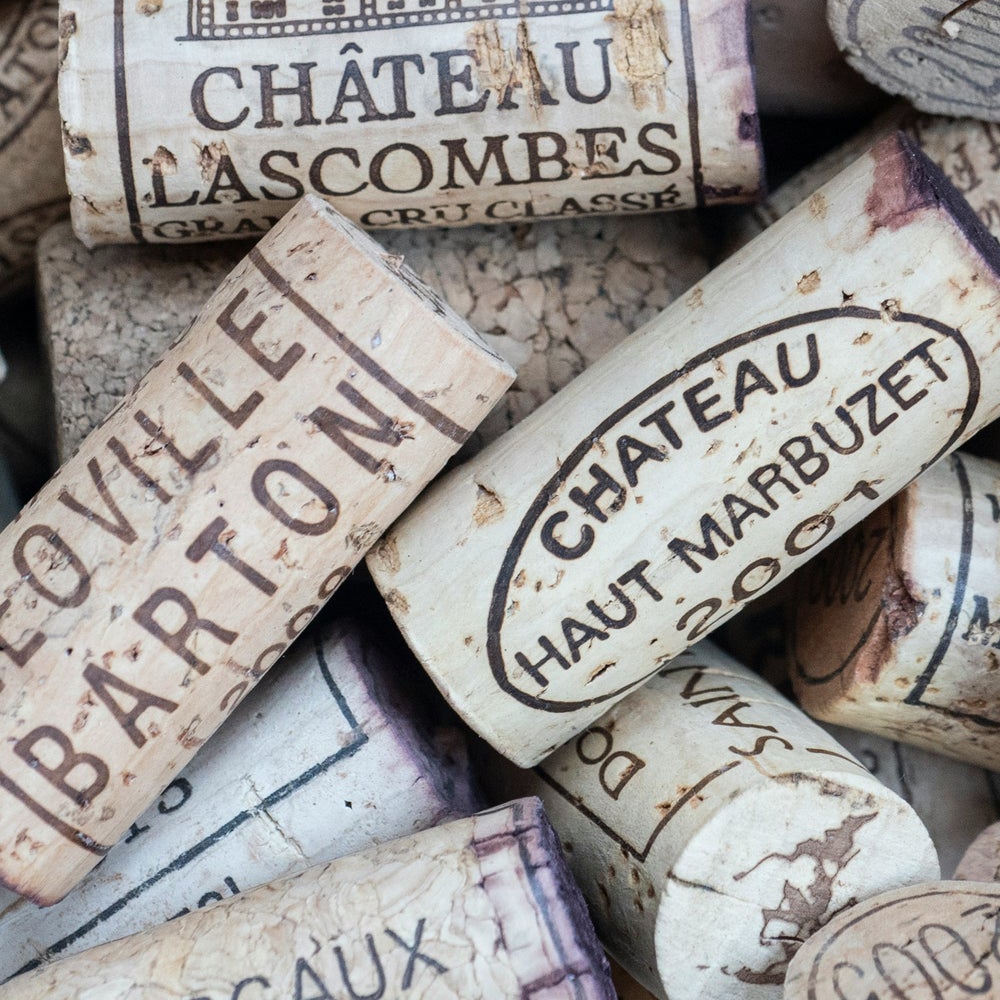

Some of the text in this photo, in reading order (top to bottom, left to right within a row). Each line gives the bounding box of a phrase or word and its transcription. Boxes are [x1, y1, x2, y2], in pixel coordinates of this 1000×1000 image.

[143, 121, 682, 210] LASCOMBES
[191, 42, 614, 132] CHÂTEAU
[153, 213, 285, 243] GRA
[0, 286, 306, 680] EOVILLE
[512, 558, 665, 688] HAUT
[667, 338, 952, 574] MARBUZET
[540, 333, 823, 562] CHATEAU
[12, 380, 401, 806] BARTON
